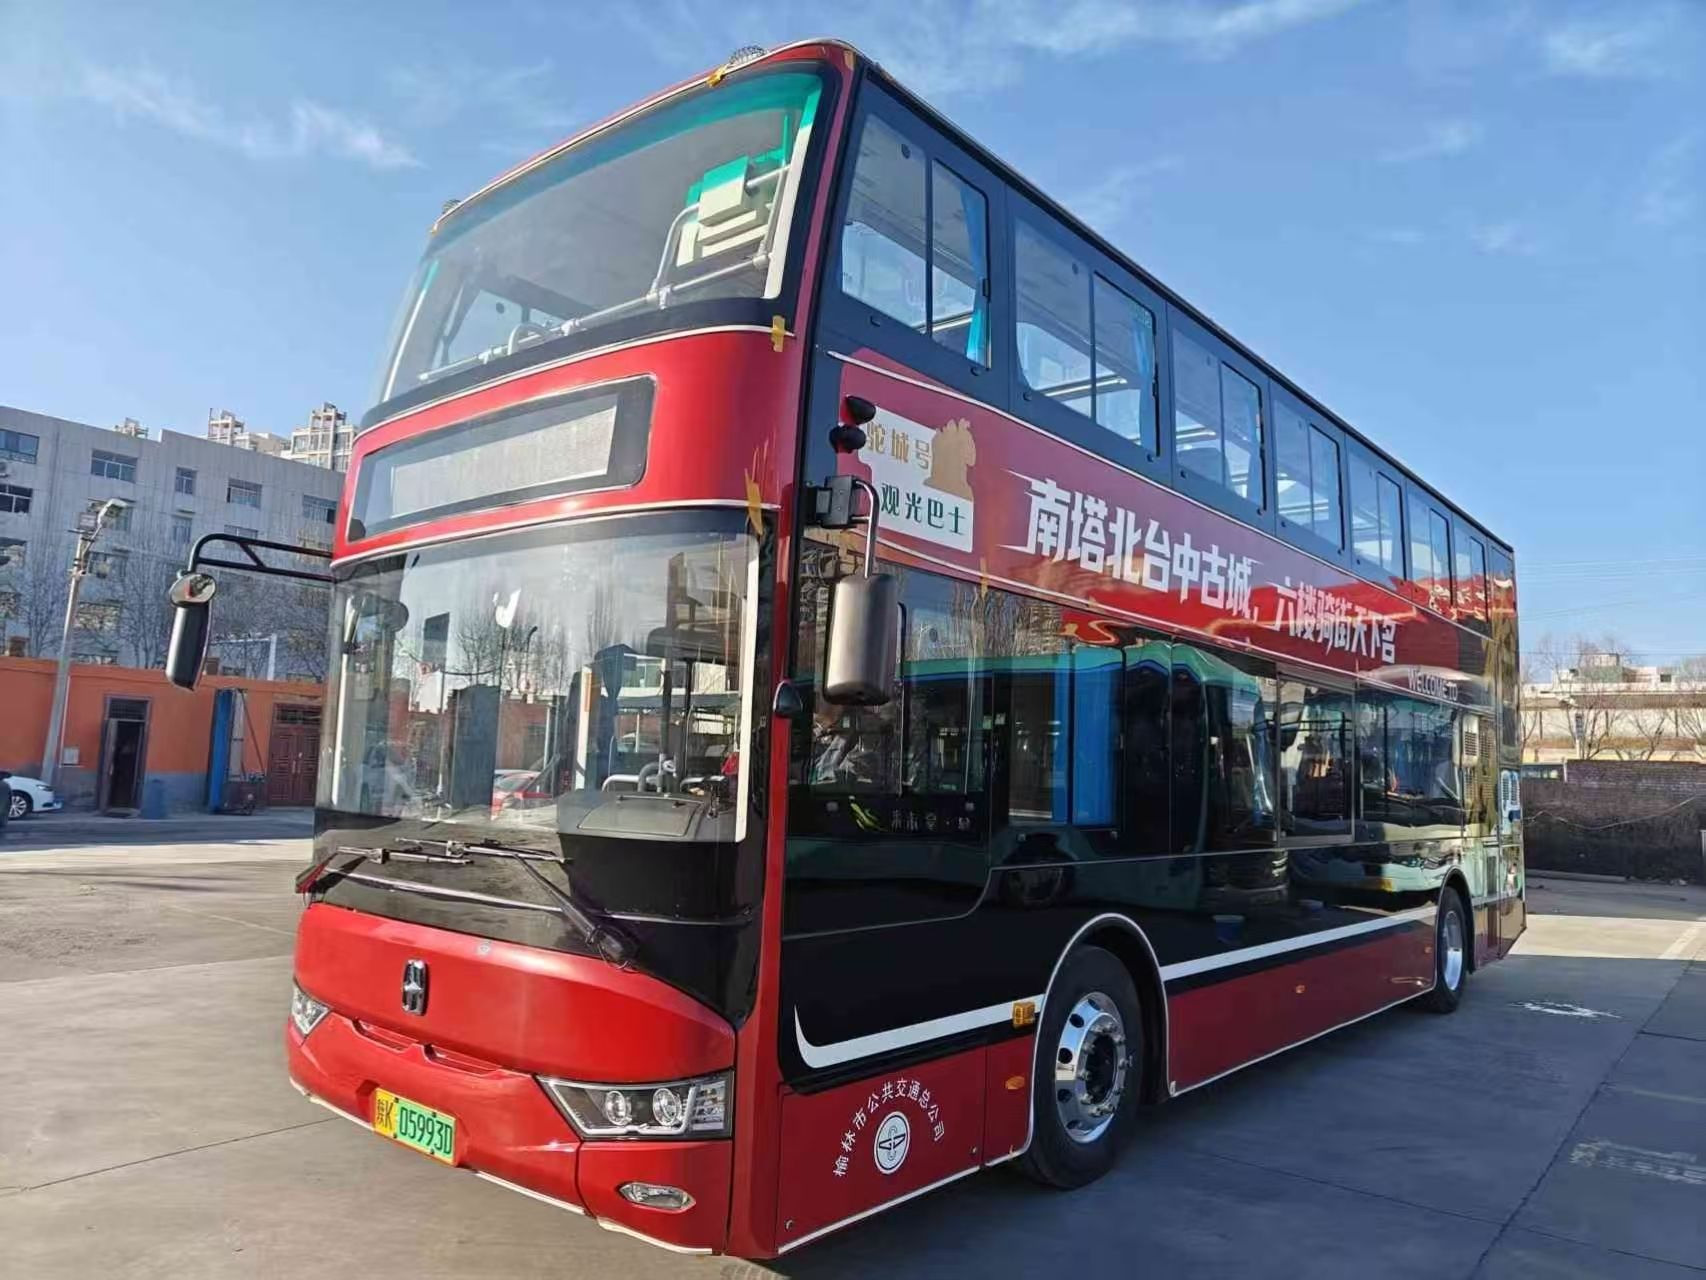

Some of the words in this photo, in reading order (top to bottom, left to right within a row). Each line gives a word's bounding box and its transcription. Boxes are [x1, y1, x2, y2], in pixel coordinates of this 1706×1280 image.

[880, 482, 966, 536] 观光巴士
[1408, 667, 1447, 698] WELCOME
[832, 1077, 945, 1177] 榆林市公共交通总公司
